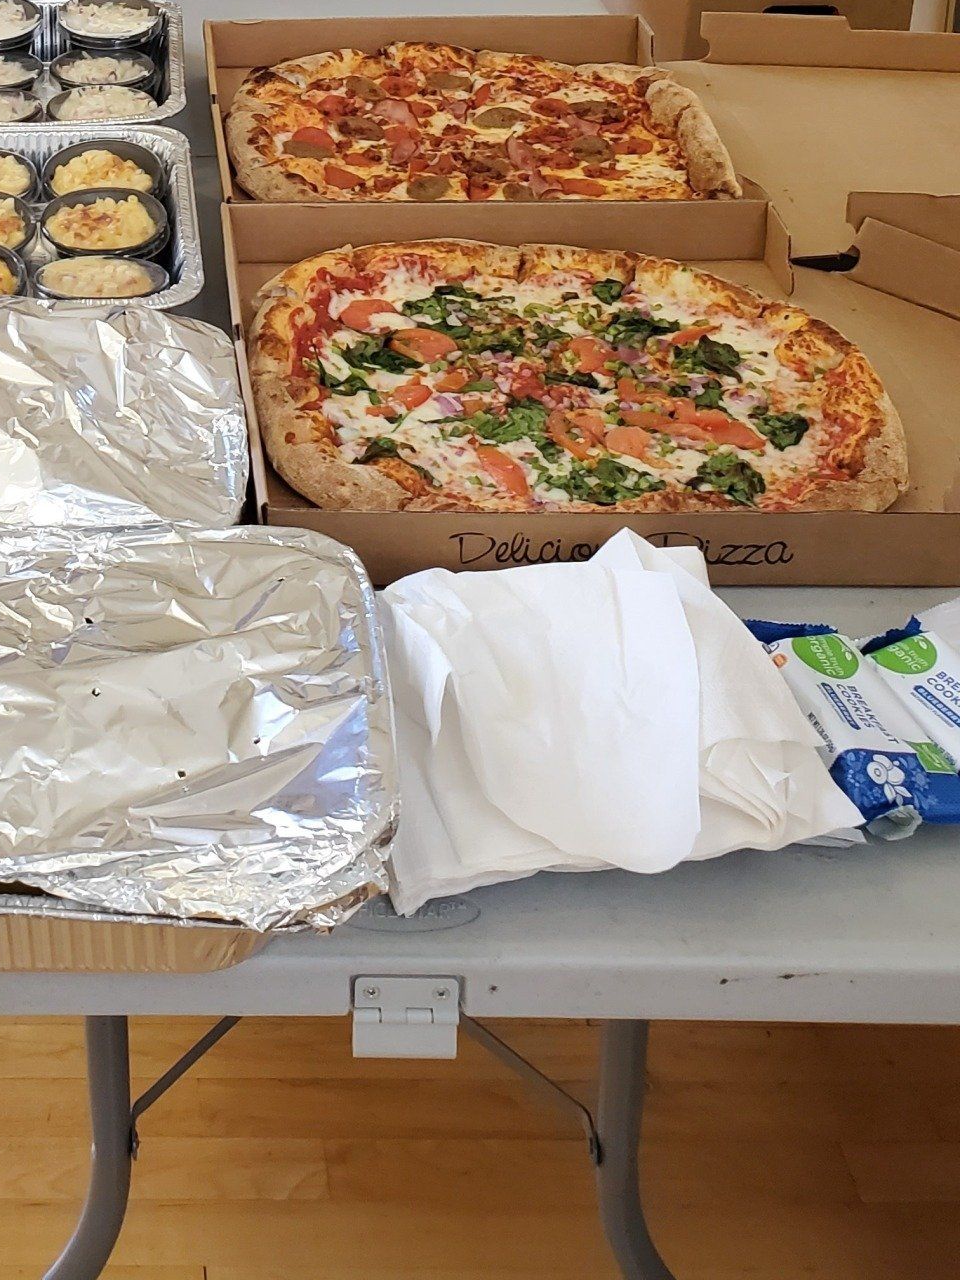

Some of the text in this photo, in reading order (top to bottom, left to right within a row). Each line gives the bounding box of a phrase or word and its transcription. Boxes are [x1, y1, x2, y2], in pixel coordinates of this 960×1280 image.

[449, 531, 600, 565] Delicio
[886, 644, 921, 671] ganic
[926, 677, 960, 709] COOK
[935, 671, 960, 693] BRE
[836, 683, 875, 728] COOKIES
